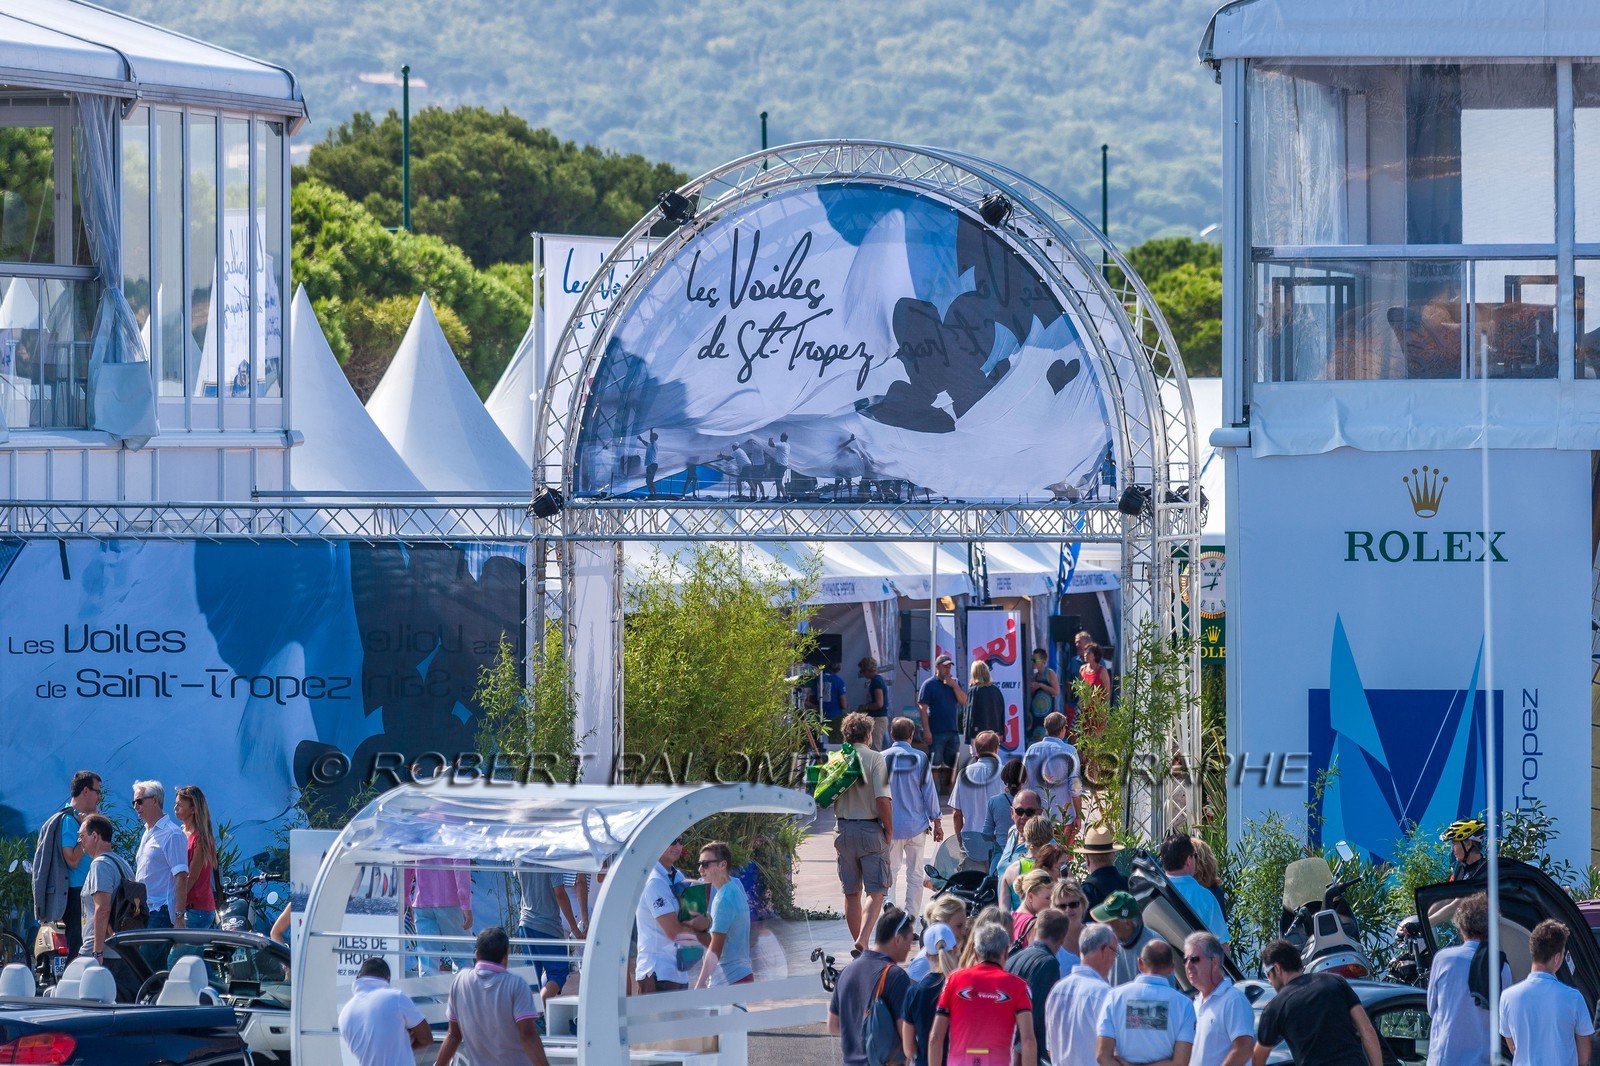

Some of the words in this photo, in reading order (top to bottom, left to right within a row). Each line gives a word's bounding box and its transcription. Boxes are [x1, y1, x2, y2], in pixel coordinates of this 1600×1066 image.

[729, 227, 826, 310] Voiles
[697, 314, 730, 360] de
[737, 308, 875, 392] St-Tropez
[1344, 530, 1509, 563] ROLEX
[8, 636, 55, 655] Les
[64, 623, 187, 654] Voiles
[36, 680, 67, 699] de
[1001, 681, 1017, 689] ONLY
[1515, 688, 1543, 826] Tropez
[371, 938, 387, 950] DE
